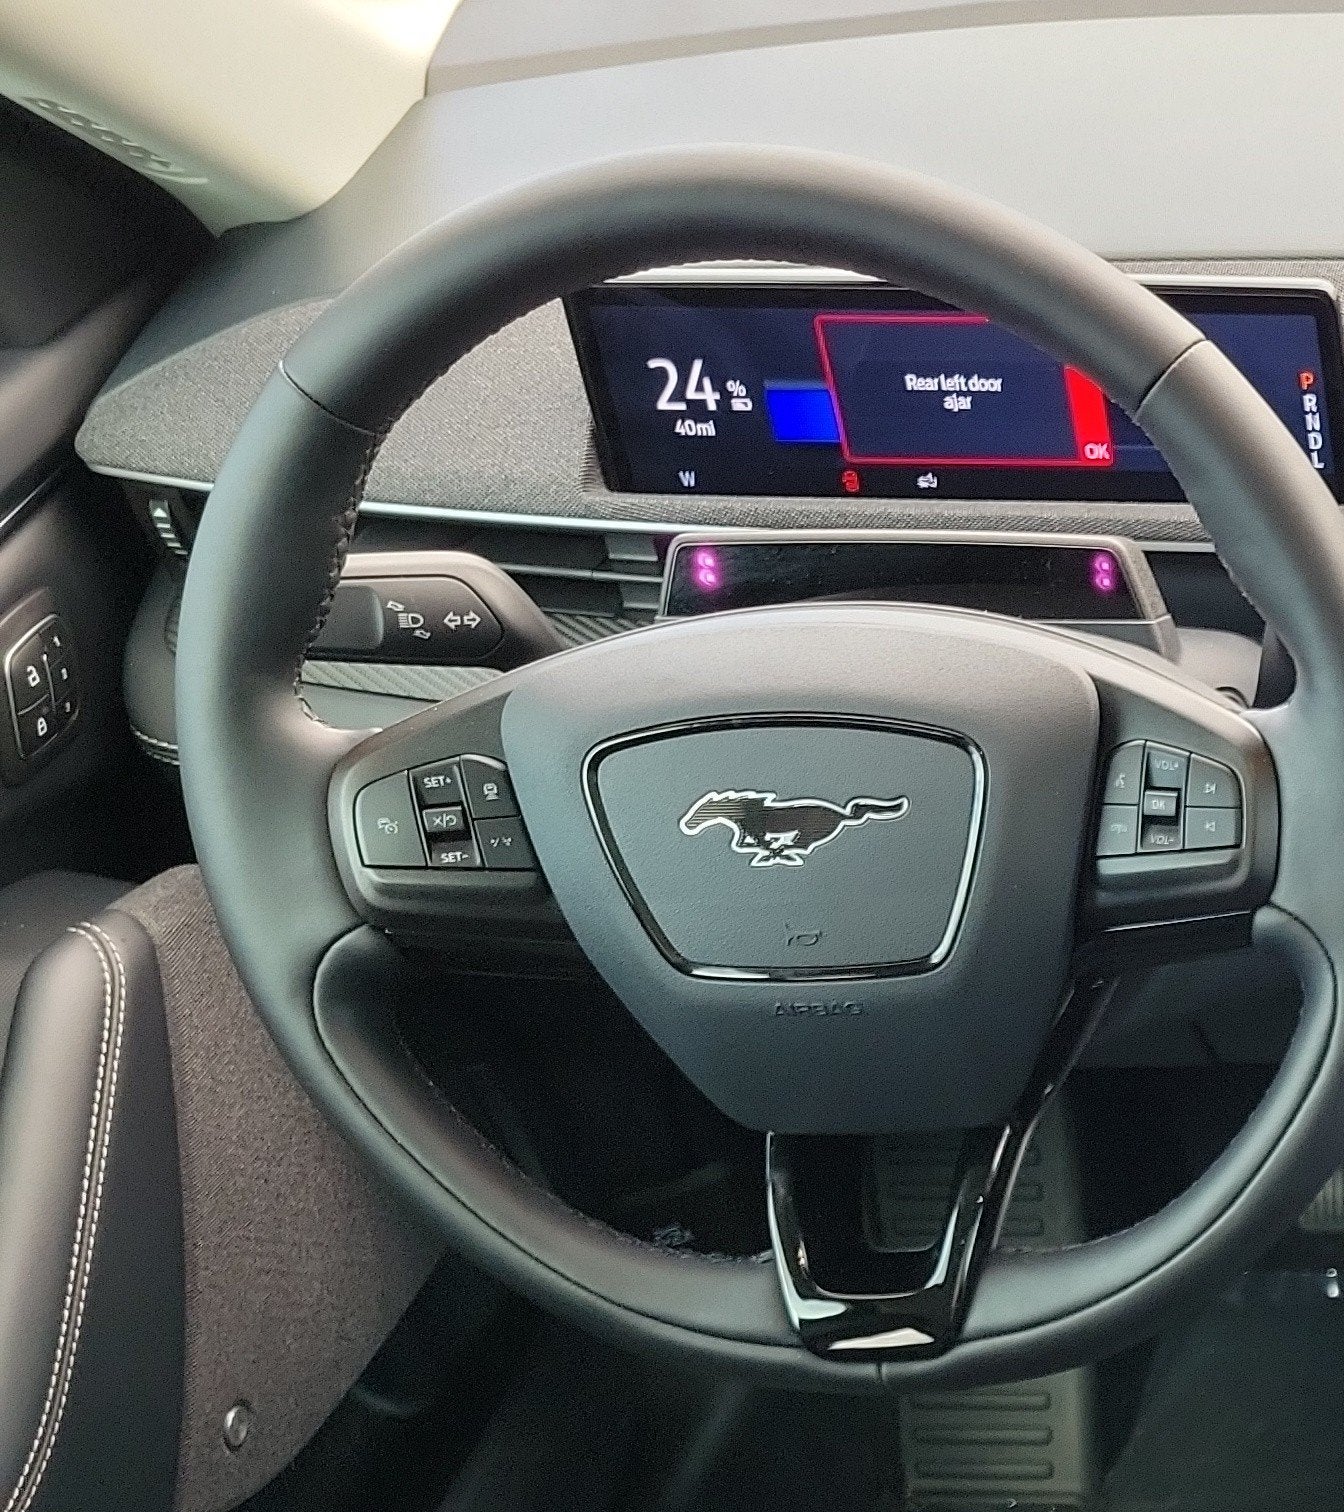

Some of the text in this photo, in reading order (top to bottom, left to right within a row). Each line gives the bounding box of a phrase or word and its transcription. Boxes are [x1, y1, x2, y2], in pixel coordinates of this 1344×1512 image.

[646, 357, 721, 411] 24
[904, 373, 1003, 392] Rear left door
[1300, 371, 1314, 390] P
[943, 393, 973, 412] ajar
[1303, 393, 1318, 412] R
[1305, 412, 1320, 431] N
[1307, 432, 1323, 450] D
[1083, 442, 1110, 460] OK
[1311, 450, 1325, 469] L
[678, 470, 695, 487] W
